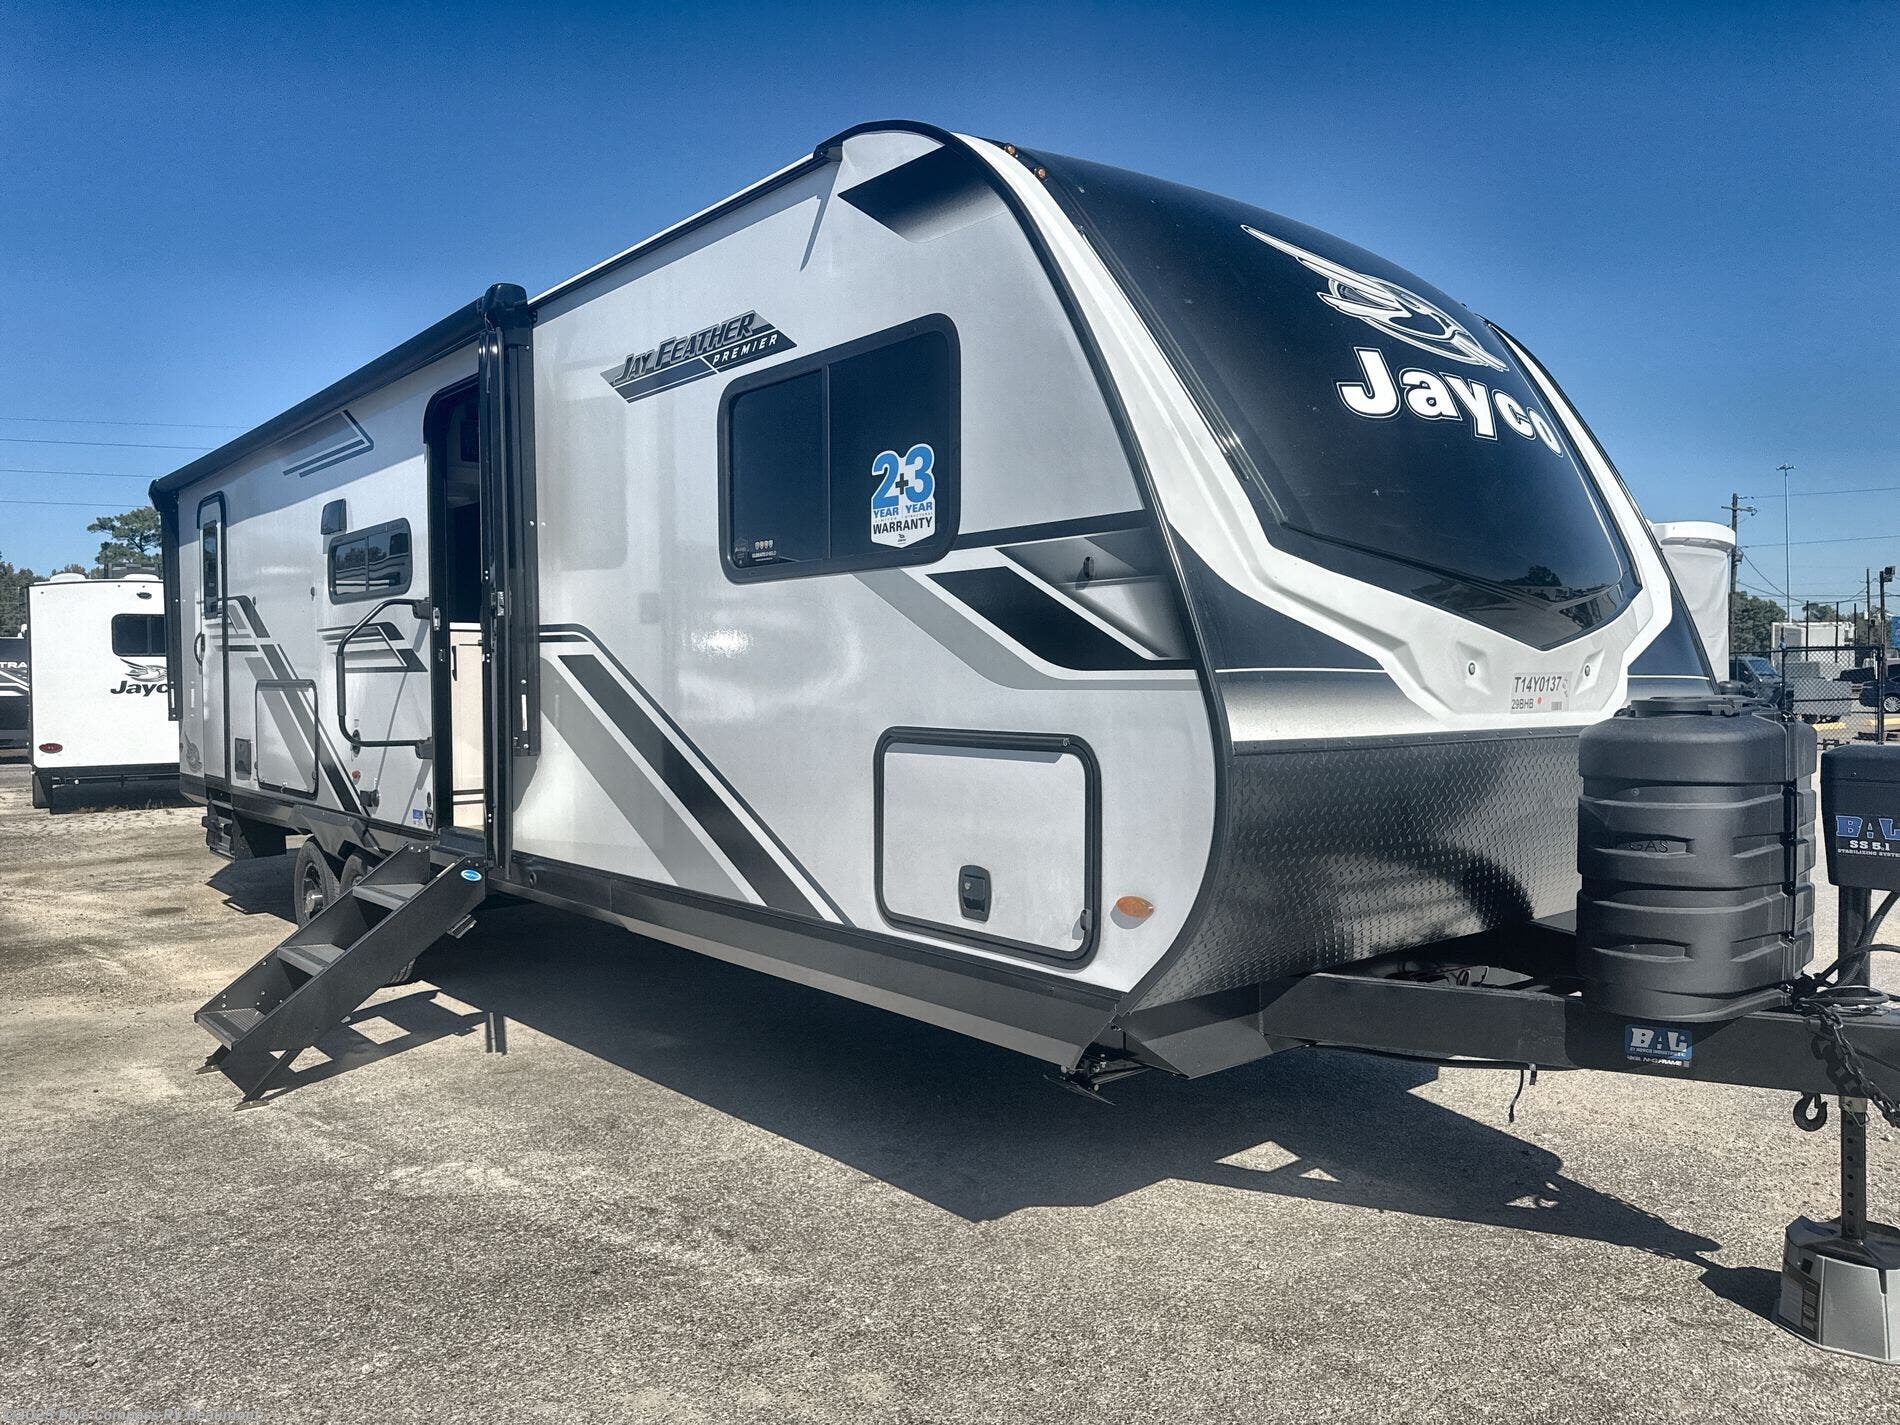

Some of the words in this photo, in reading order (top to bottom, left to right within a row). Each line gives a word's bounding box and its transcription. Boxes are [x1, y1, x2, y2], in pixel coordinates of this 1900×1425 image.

[614, 350, 653, 384] JAY
[653, 310, 757, 371] FEATHER
[712, 334, 778, 366] PREMIER
[1337, 346, 1563, 457] Jayco
[873, 507, 899, 518] YEAR
[905, 501, 933, 513] YEAR
[873, 516, 933, 534] WARRANTY
[0, 661, 28, 669] TRA
[110, 680, 168, 697] Jayc
[1514, 676, 1563, 693] T14Y0137
[1511, 698, 1534, 710] 29BHB
[1837, 848, 1878, 856] STABILIZING
[1849, 839, 1869, 849] SS
